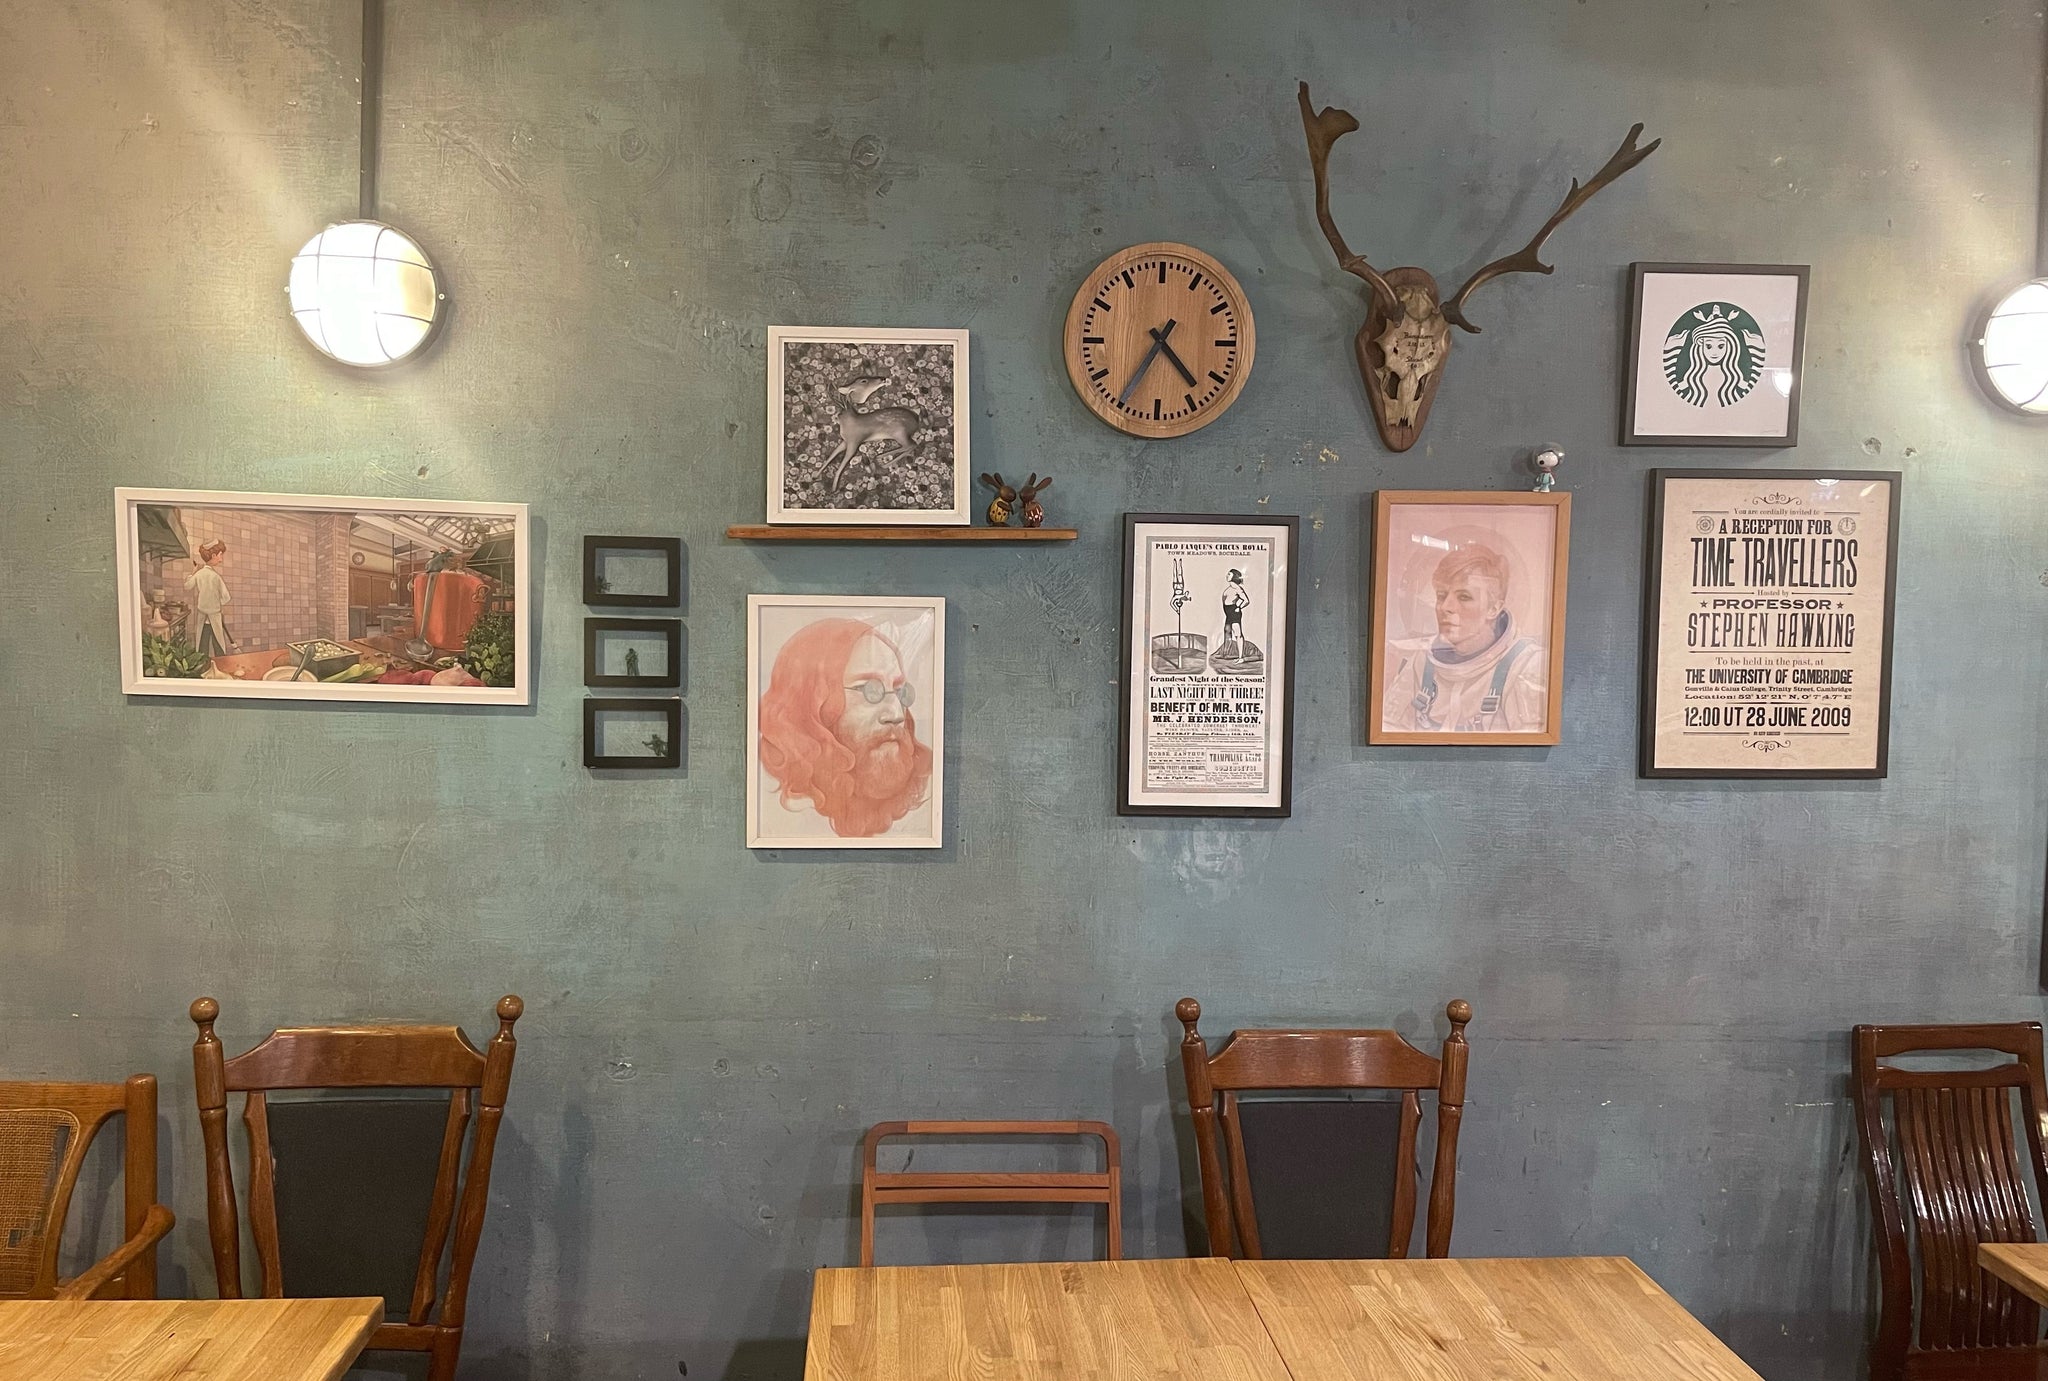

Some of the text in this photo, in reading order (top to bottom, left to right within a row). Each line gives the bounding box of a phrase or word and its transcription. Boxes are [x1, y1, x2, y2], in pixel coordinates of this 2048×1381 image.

[1760, 508, 1788, 516] cordially
[1719, 519, 1833, 535] A RECEPTION FOR
[1690, 537, 1858, 587] TIME TRAVELLERS
[1781, 589, 1789, 597] by
[1713, 599, 1832, 610] PROFESSOR
[1688, 612, 1855, 648] STEPHEN HAWKING
[1715, 657, 1824, 667] To be held in the past, at
[1685, 669, 1853, 684] THE UNIVERSITY OF CAMBRIDGE
[1151, 687, 1264, 699] LAST NIGHT BUT THREE!
[1151, 703, 1263, 715] BENEFIT OF MR. KITE,
[1187, 716, 1261, 724] HENDERSON,
[1684, 706, 1851, 727] 12:00 UT 28 JUNE 2009
